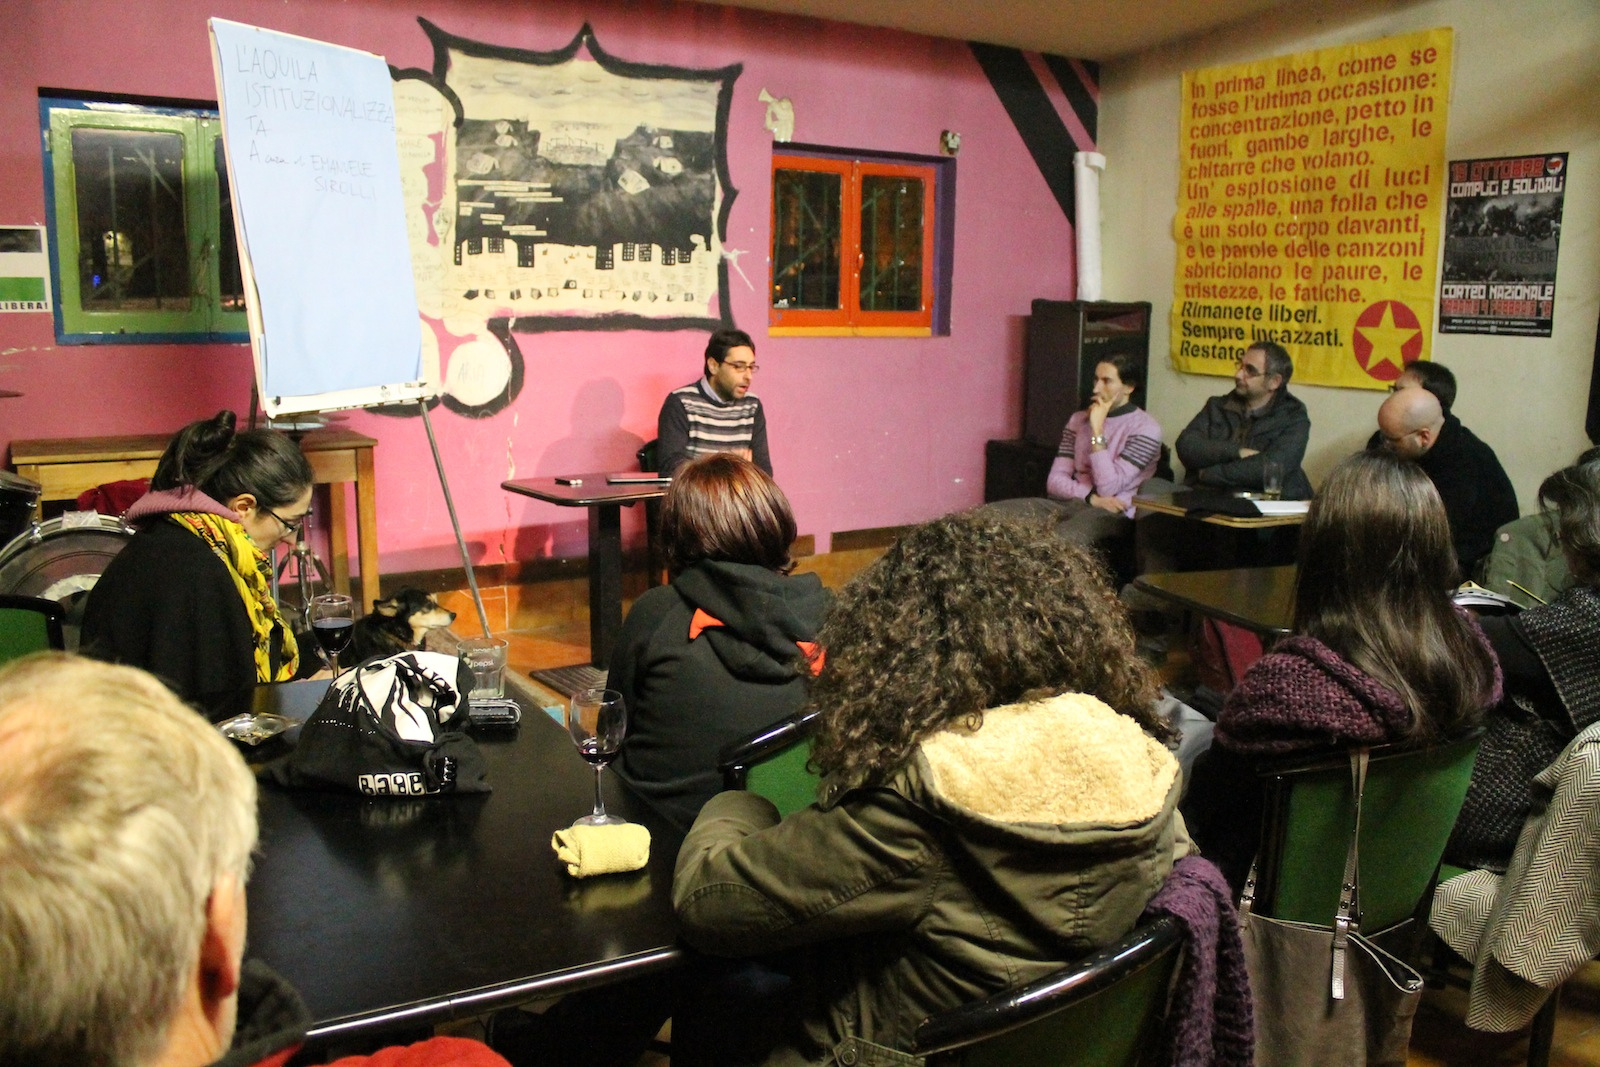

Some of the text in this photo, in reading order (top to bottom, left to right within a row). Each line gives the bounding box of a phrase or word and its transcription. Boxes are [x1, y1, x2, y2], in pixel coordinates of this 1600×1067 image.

[236, 44, 318, 83] L'AQUILA
[1192, 47, 1437, 99] In prima linea, come se
[1192, 99, 1239, 118] fosse
[1317, 72, 1437, 99] occasione:
[1190, 95, 1434, 139] concentrazione, petto in
[1190, 118, 1432, 159] fuori, gambe larghe, le
[1188, 150, 1374, 179] chitarre che volano.
[1225, 175, 1336, 200] esplosione
[1349, 169, 1369, 189] di
[1385, 165, 1430, 186] luci
[1186, 191, 1428, 220] alle spalle, una folla che
[1200, 220, 1220, 238] un
[1227, 218, 1267, 237] solo
[1274, 220, 1329, 239] corpo
[1337, 213, 1425, 238] davanti,
[1186, 238, 1424, 261] e le parole delle canzoni
[1185, 261, 1422, 283] sbriciolano le paure, le
[1185, 281, 1366, 302] tristezze, le fatiche.
[0, 302, 48, 310] LIBERA!
[1182, 302, 1322, 324] Rimanete liberi.
[1182, 321, 1343, 347] Sempre incazzati.
[1180, 340, 1244, 361] Restate
